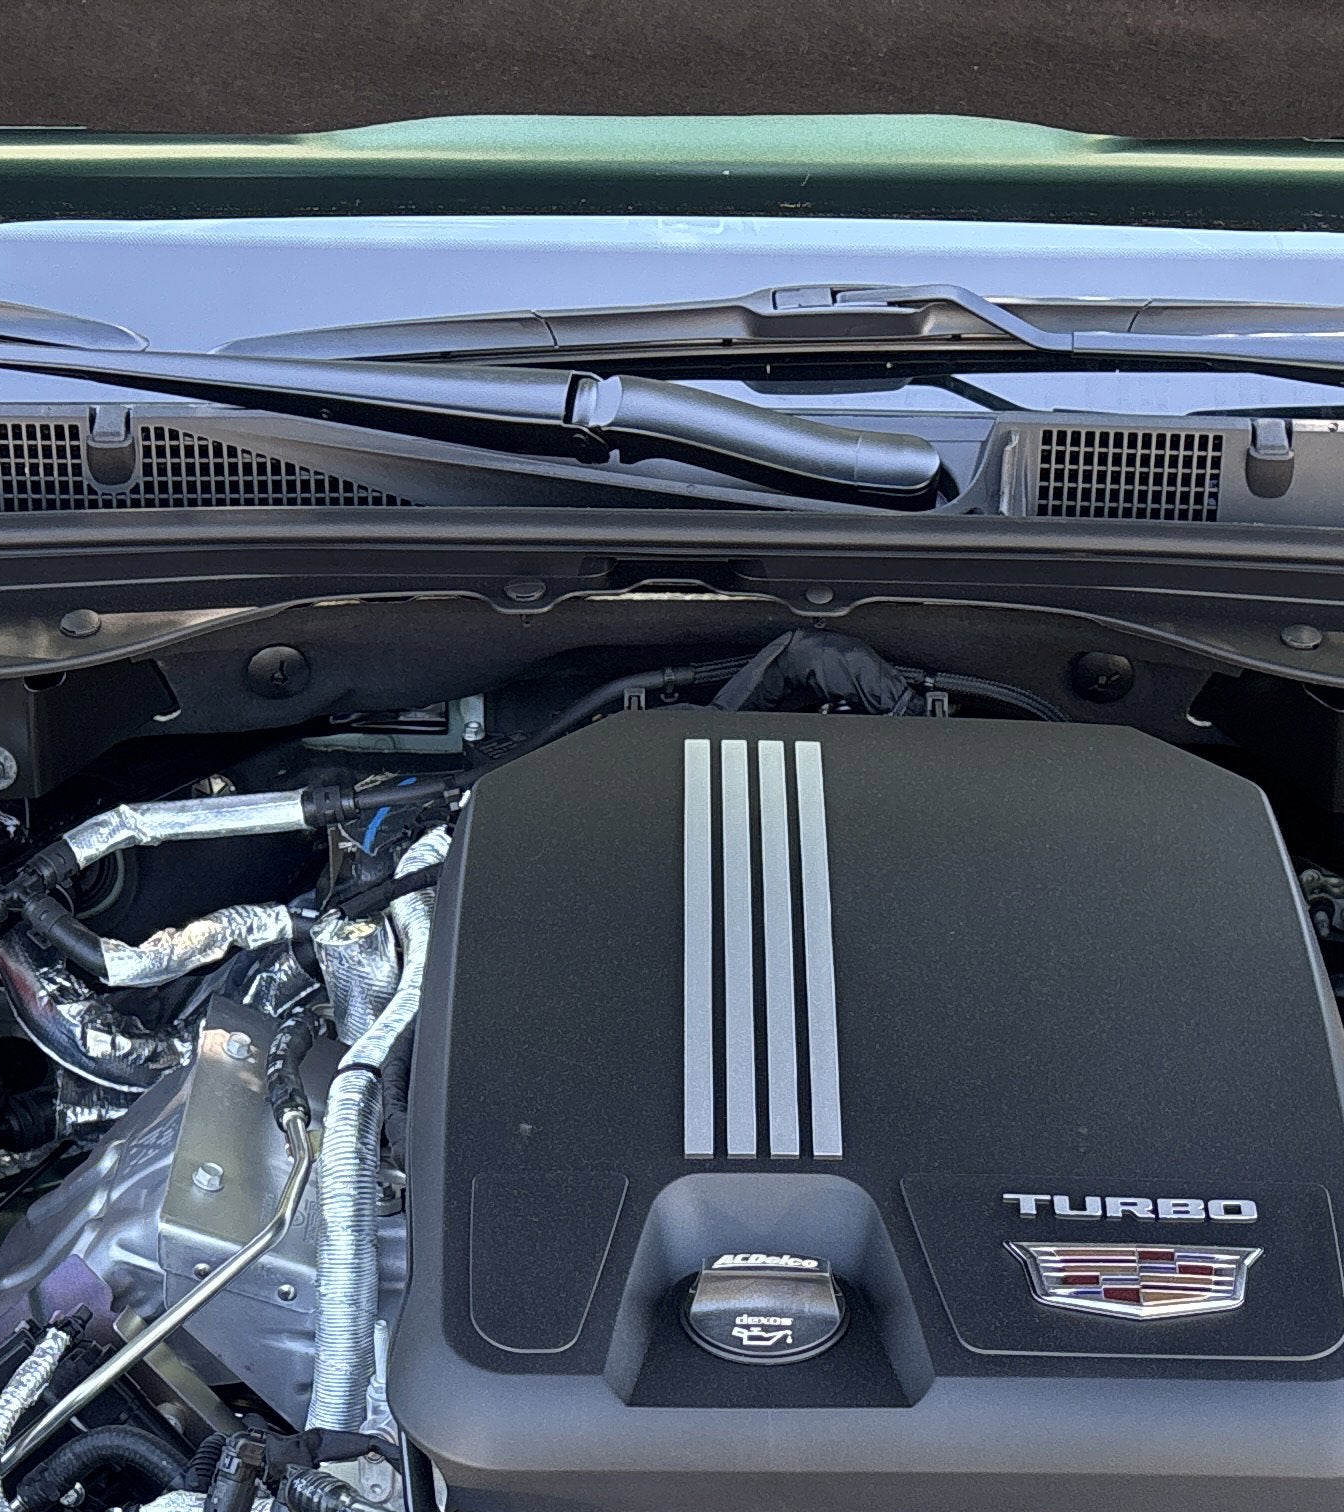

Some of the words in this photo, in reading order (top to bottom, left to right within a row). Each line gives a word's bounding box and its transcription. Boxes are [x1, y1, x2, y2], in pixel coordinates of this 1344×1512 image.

[1003, 1193, 1258, 1223] TURBO
[712, 1253, 819, 1269] ACDelco
[735, 1314, 794, 1326] dexos
